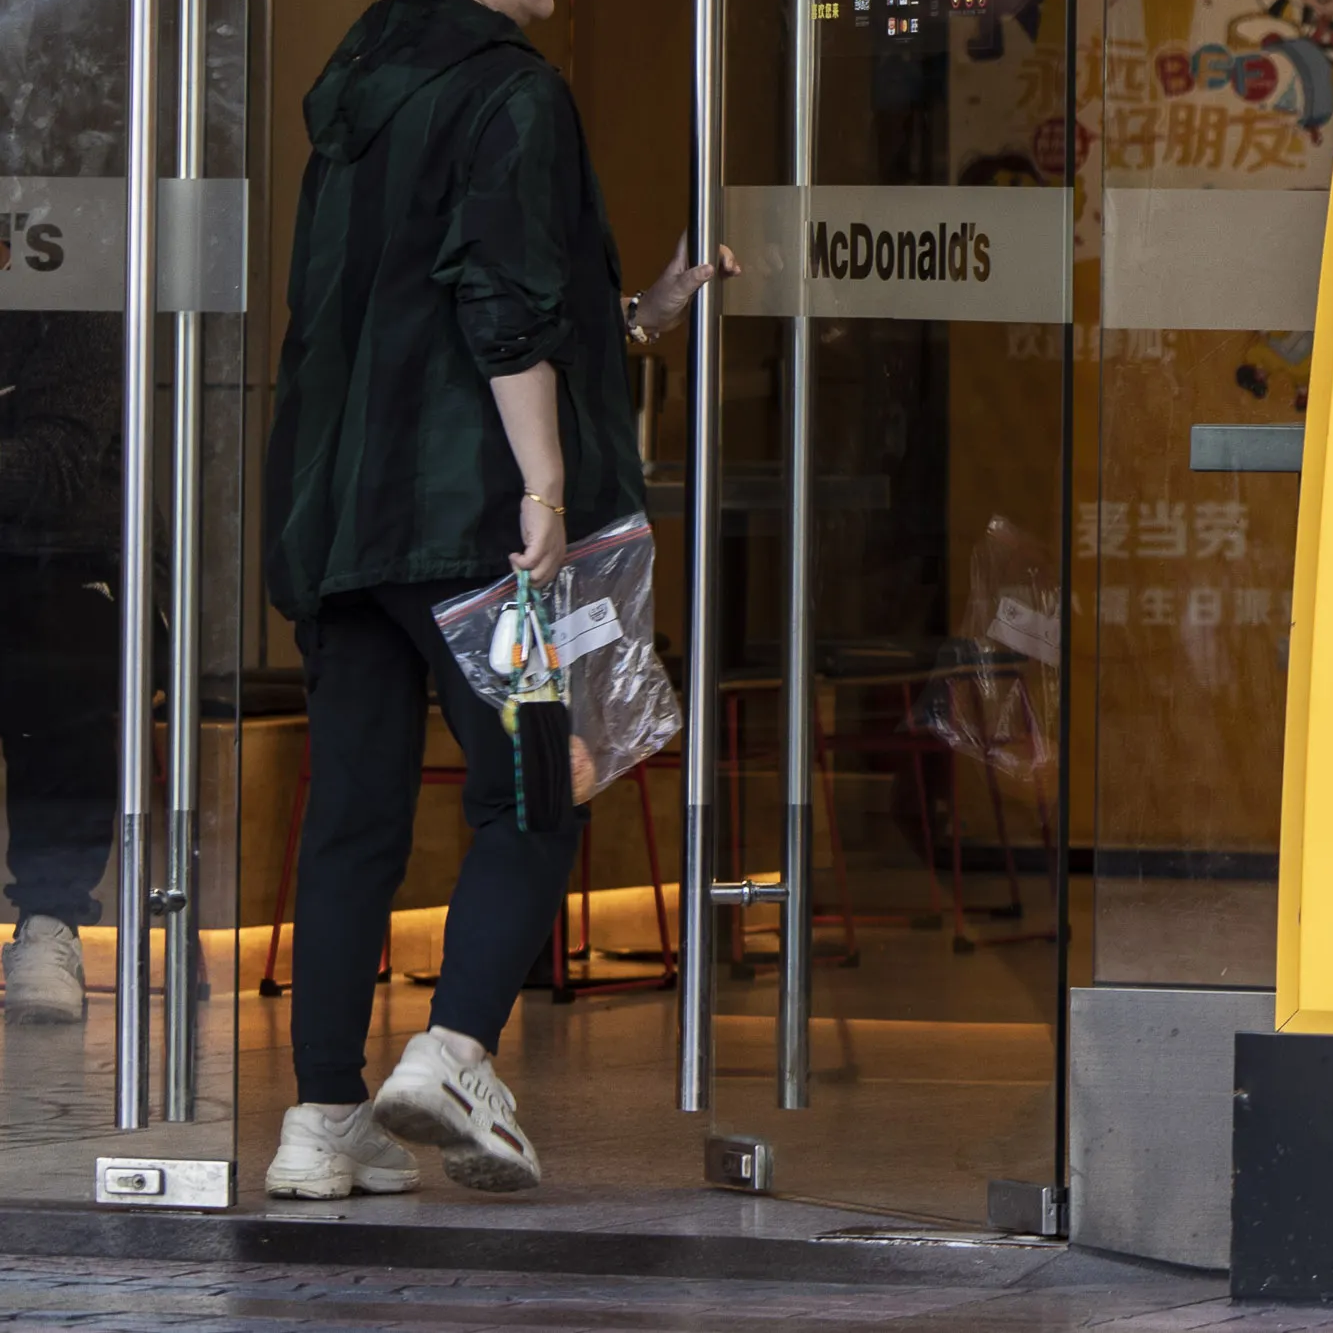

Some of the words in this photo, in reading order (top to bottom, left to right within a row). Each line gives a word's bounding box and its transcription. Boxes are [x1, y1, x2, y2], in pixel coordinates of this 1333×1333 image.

[806, 221, 992, 283] McDonald's
[1078, 501, 1249, 559] 麦当劳
